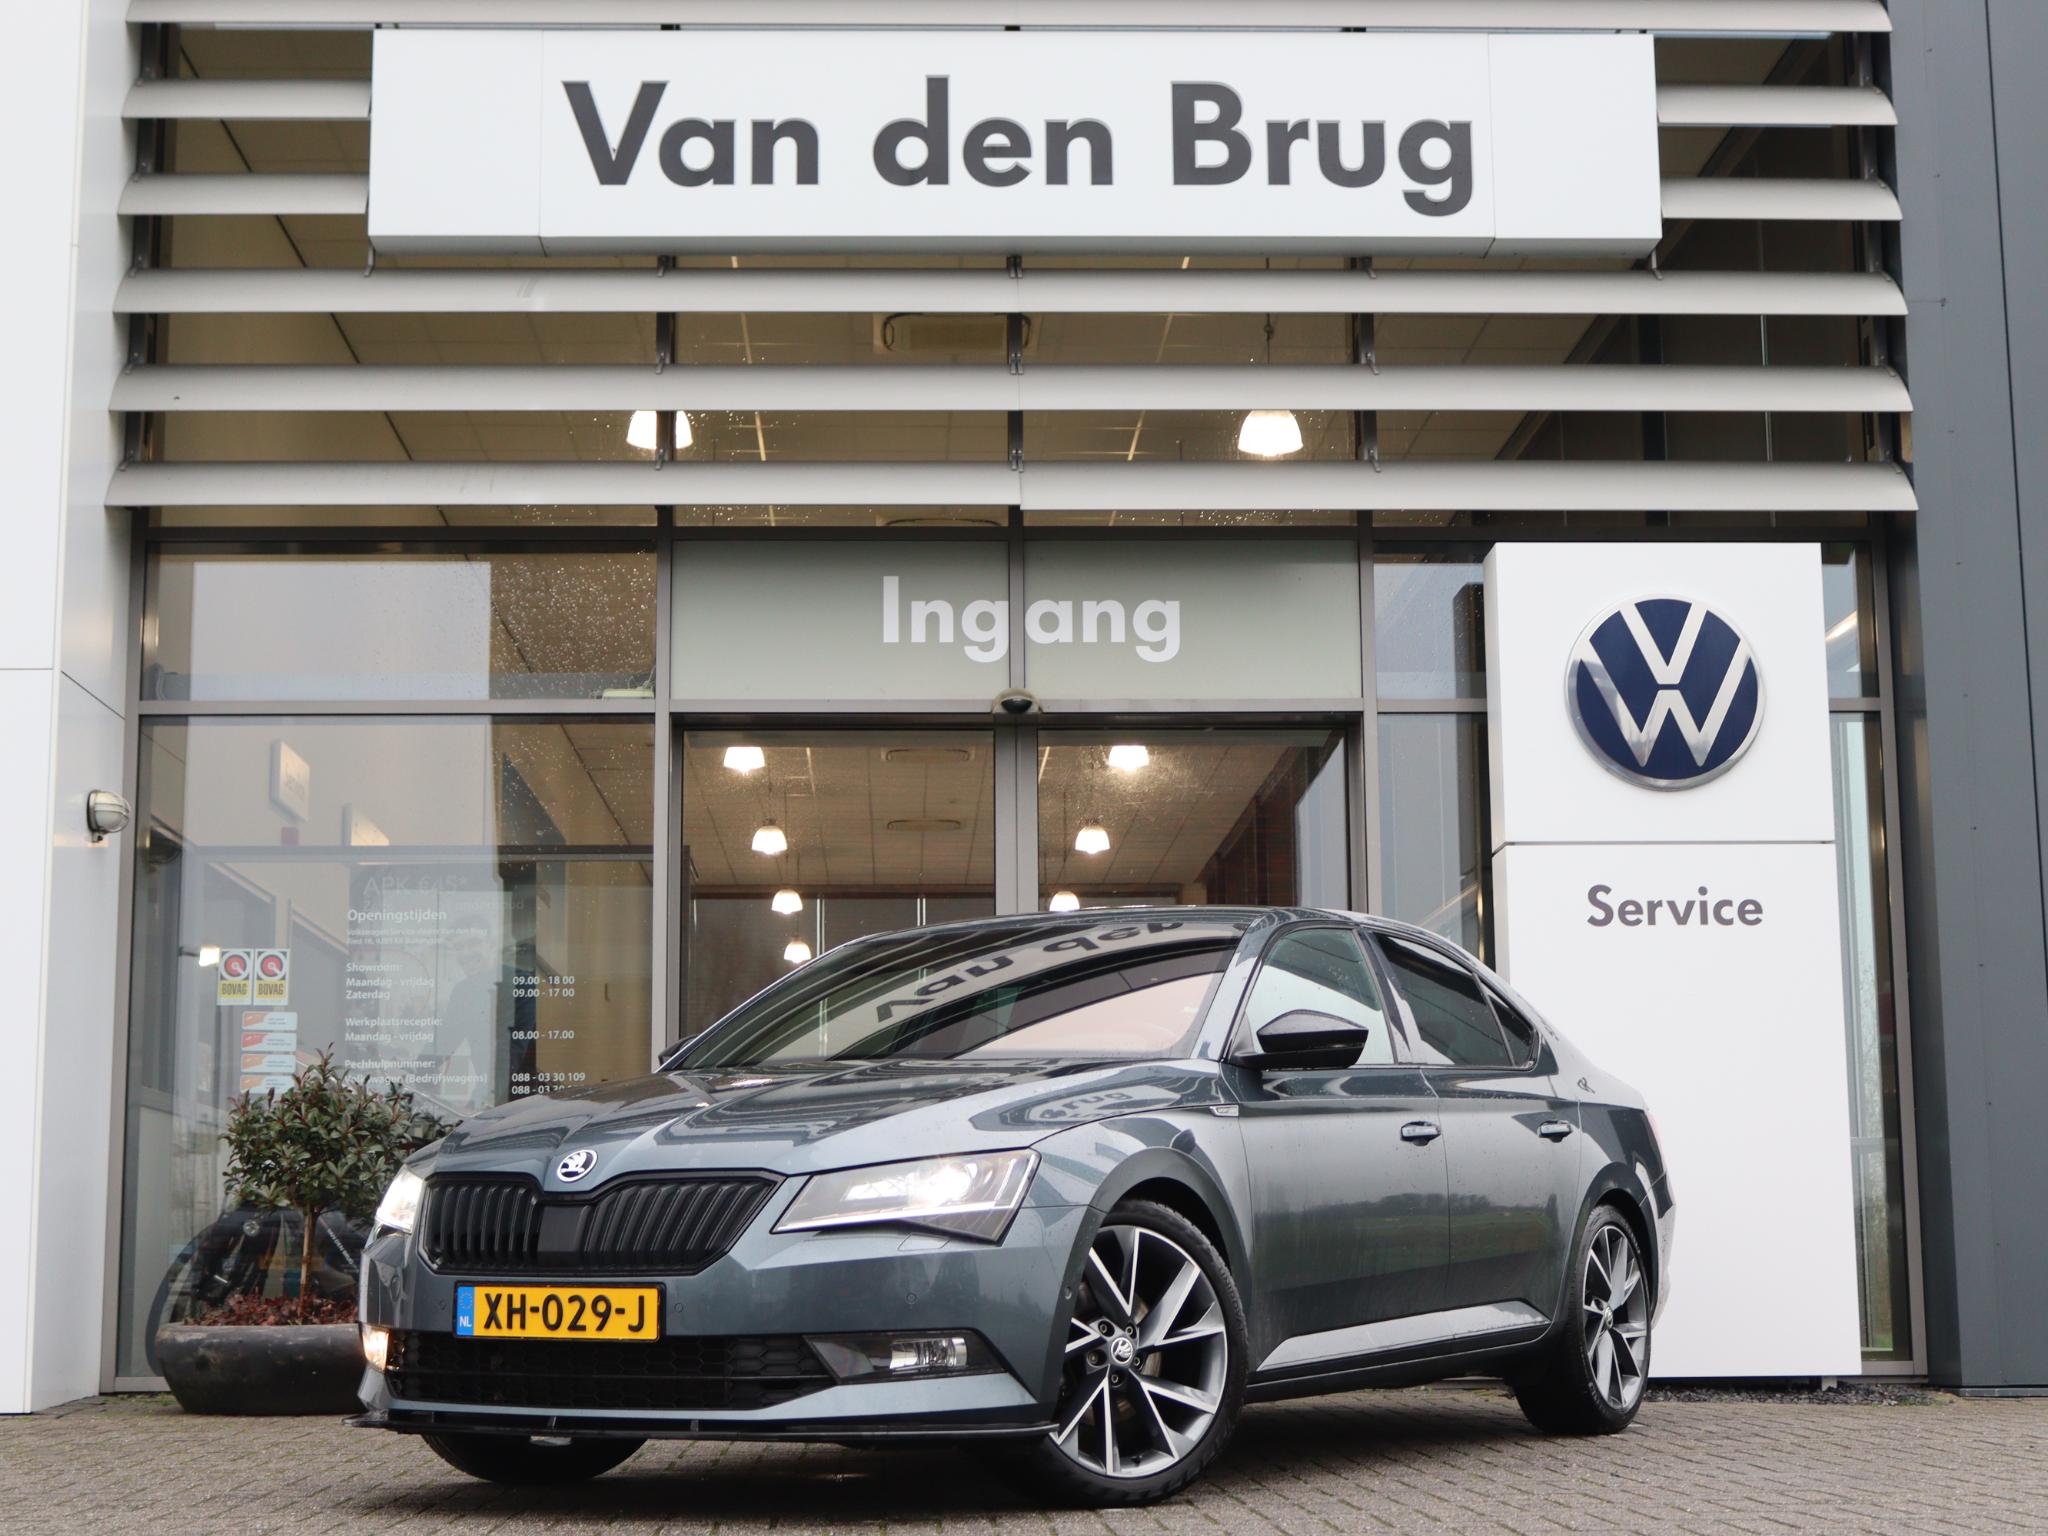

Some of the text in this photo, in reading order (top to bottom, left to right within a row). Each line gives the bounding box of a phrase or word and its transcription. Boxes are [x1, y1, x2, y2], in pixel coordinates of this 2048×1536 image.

[561, 75, 1474, 217] Van den Brug
[882, 575, 1182, 663] Ingang
[1587, 884, 1763, 927] Service
[347, 908, 447, 923] Openingstijden
[346, 978, 393, 989] Maandag
[400, 977, 435, 989] vrijdag
[512, 976, 540, 985] 09.00
[222, 983, 248, 996] BOVAG
[258, 983, 284, 996] BOVAG
[346, 990, 391, 1001] Zaterdag
[512, 988, 540, 998] 09.00
[345, 1017, 443, 1028] Werkplaatsreceptie:
[345, 1031, 392, 1042] Maandag
[400, 1031, 435, 1043] vrijdag
[512, 1030, 540, 1040] 08.00
[548, 1030, 575, 1040] 17.00
[345, 1059, 436, 1070] Pechhulpnummer:
[512, 1072, 530, 1082] 088
[538, 1072, 550, 1082] 03
[553, 1072, 565, 1082] 30
[568, 1072, 586, 1082] 109
[512, 1085, 530, 1095] 088
[483, 1292, 645, 1333] XH-029-J
[459, 1316, 472, 1328] NL
